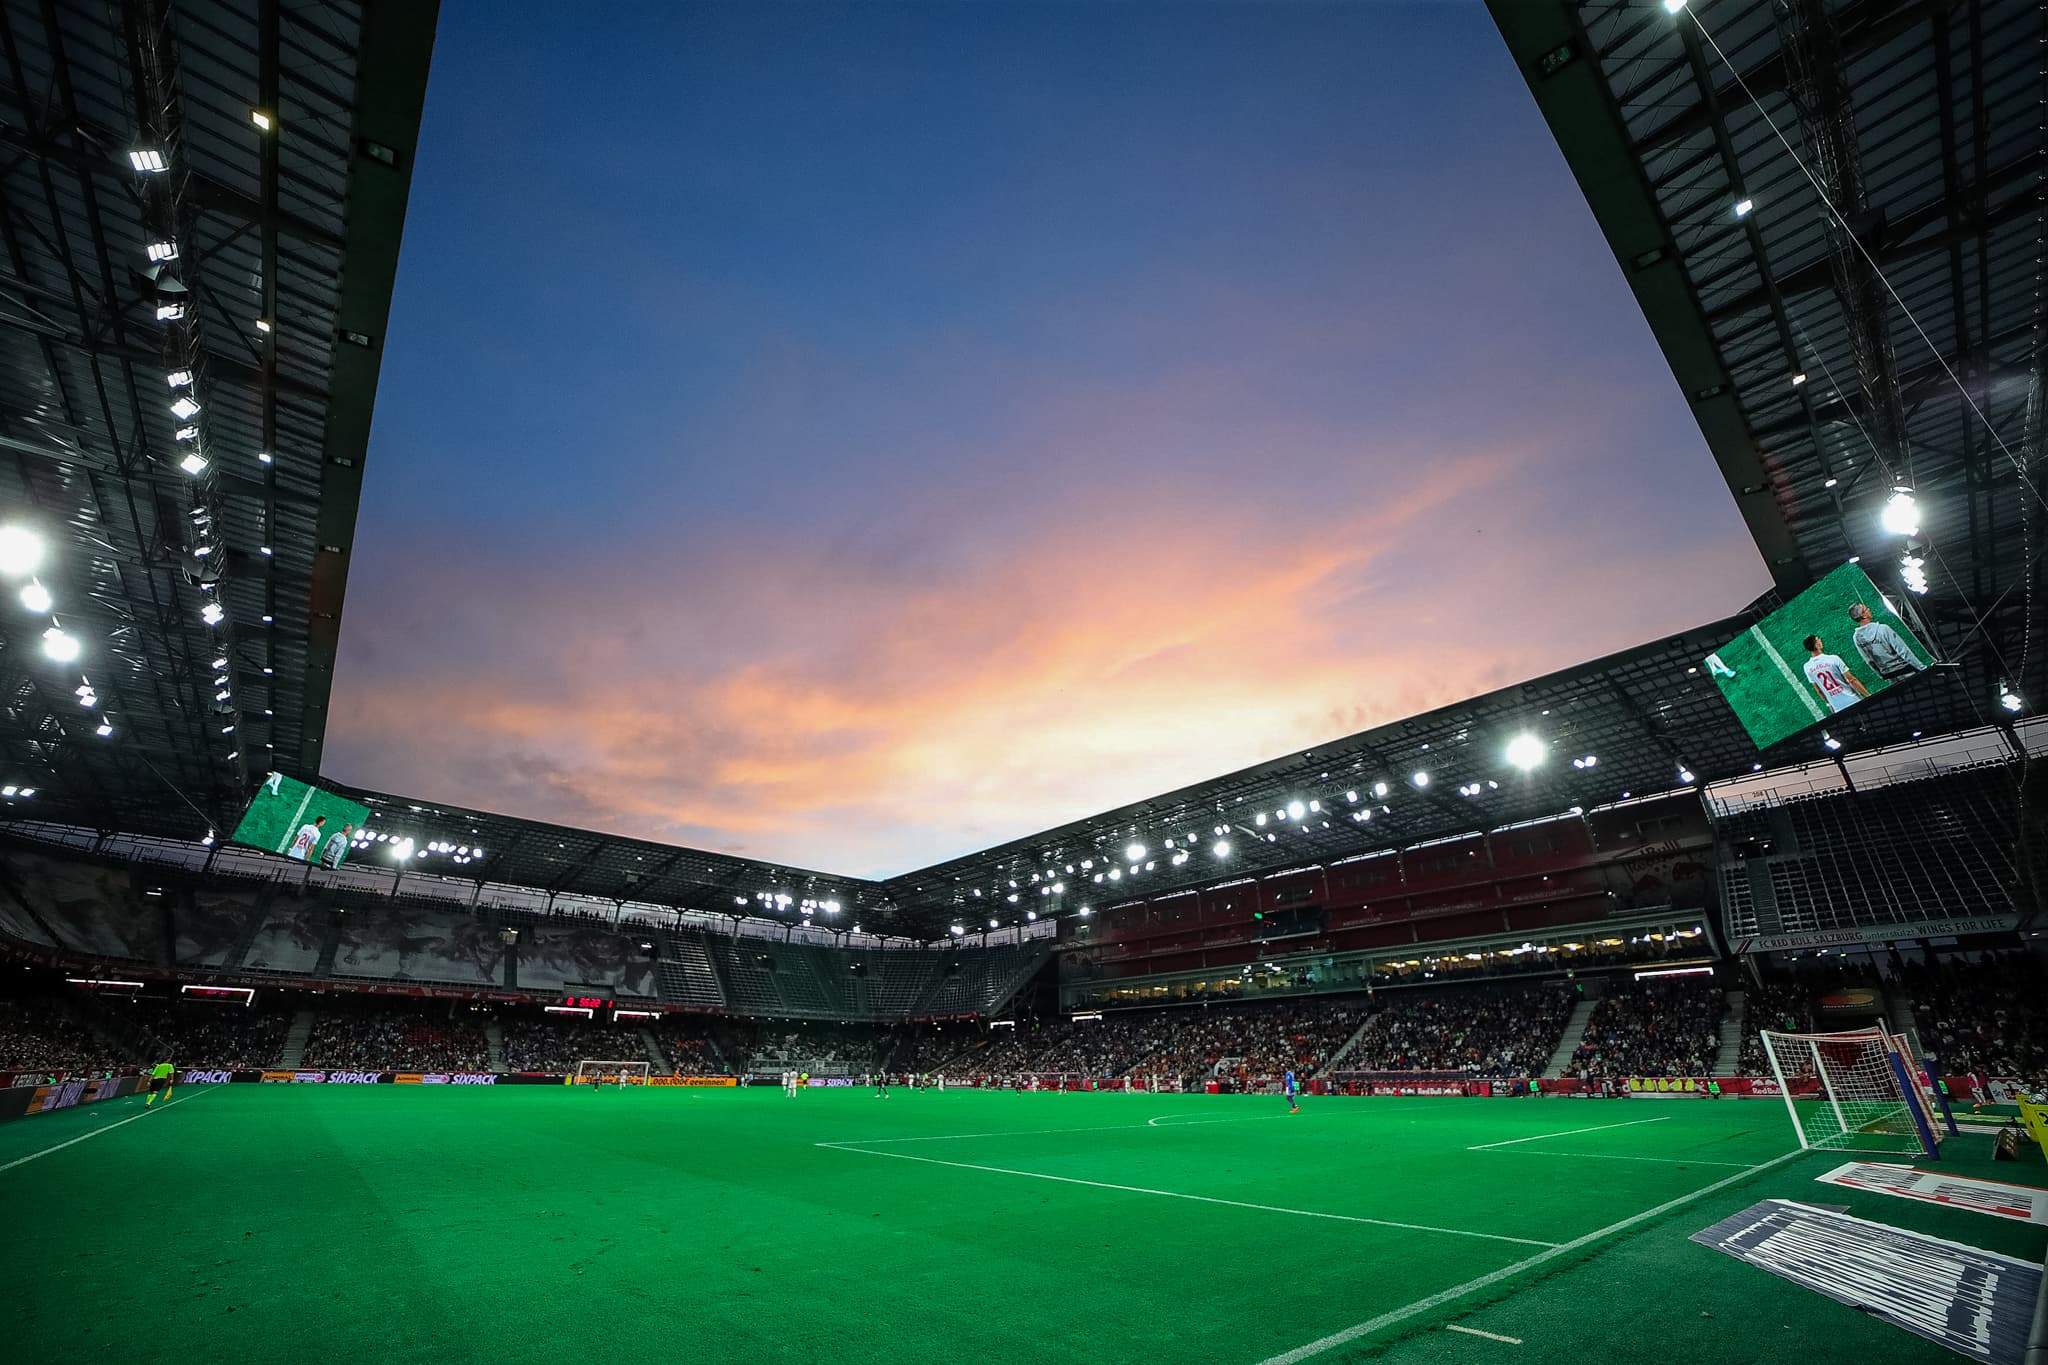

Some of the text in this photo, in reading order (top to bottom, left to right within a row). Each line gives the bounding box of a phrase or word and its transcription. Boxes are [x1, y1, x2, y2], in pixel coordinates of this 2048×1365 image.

[1817, 671, 1840, 690] 21
[1770, 937, 1788, 948] RED
[1790, 936, 1812, 947] BULL
[1814, 931, 1863, 945] SALZBURG
[1917, 923, 1953, 936] WINGS
[1956, 920, 1978, 933] FOR
[1980, 918, 2007, 930] LIFE
[328, 1071, 381, 1084] SIXPACK
[451, 1073, 498, 1085] SIXPACK
